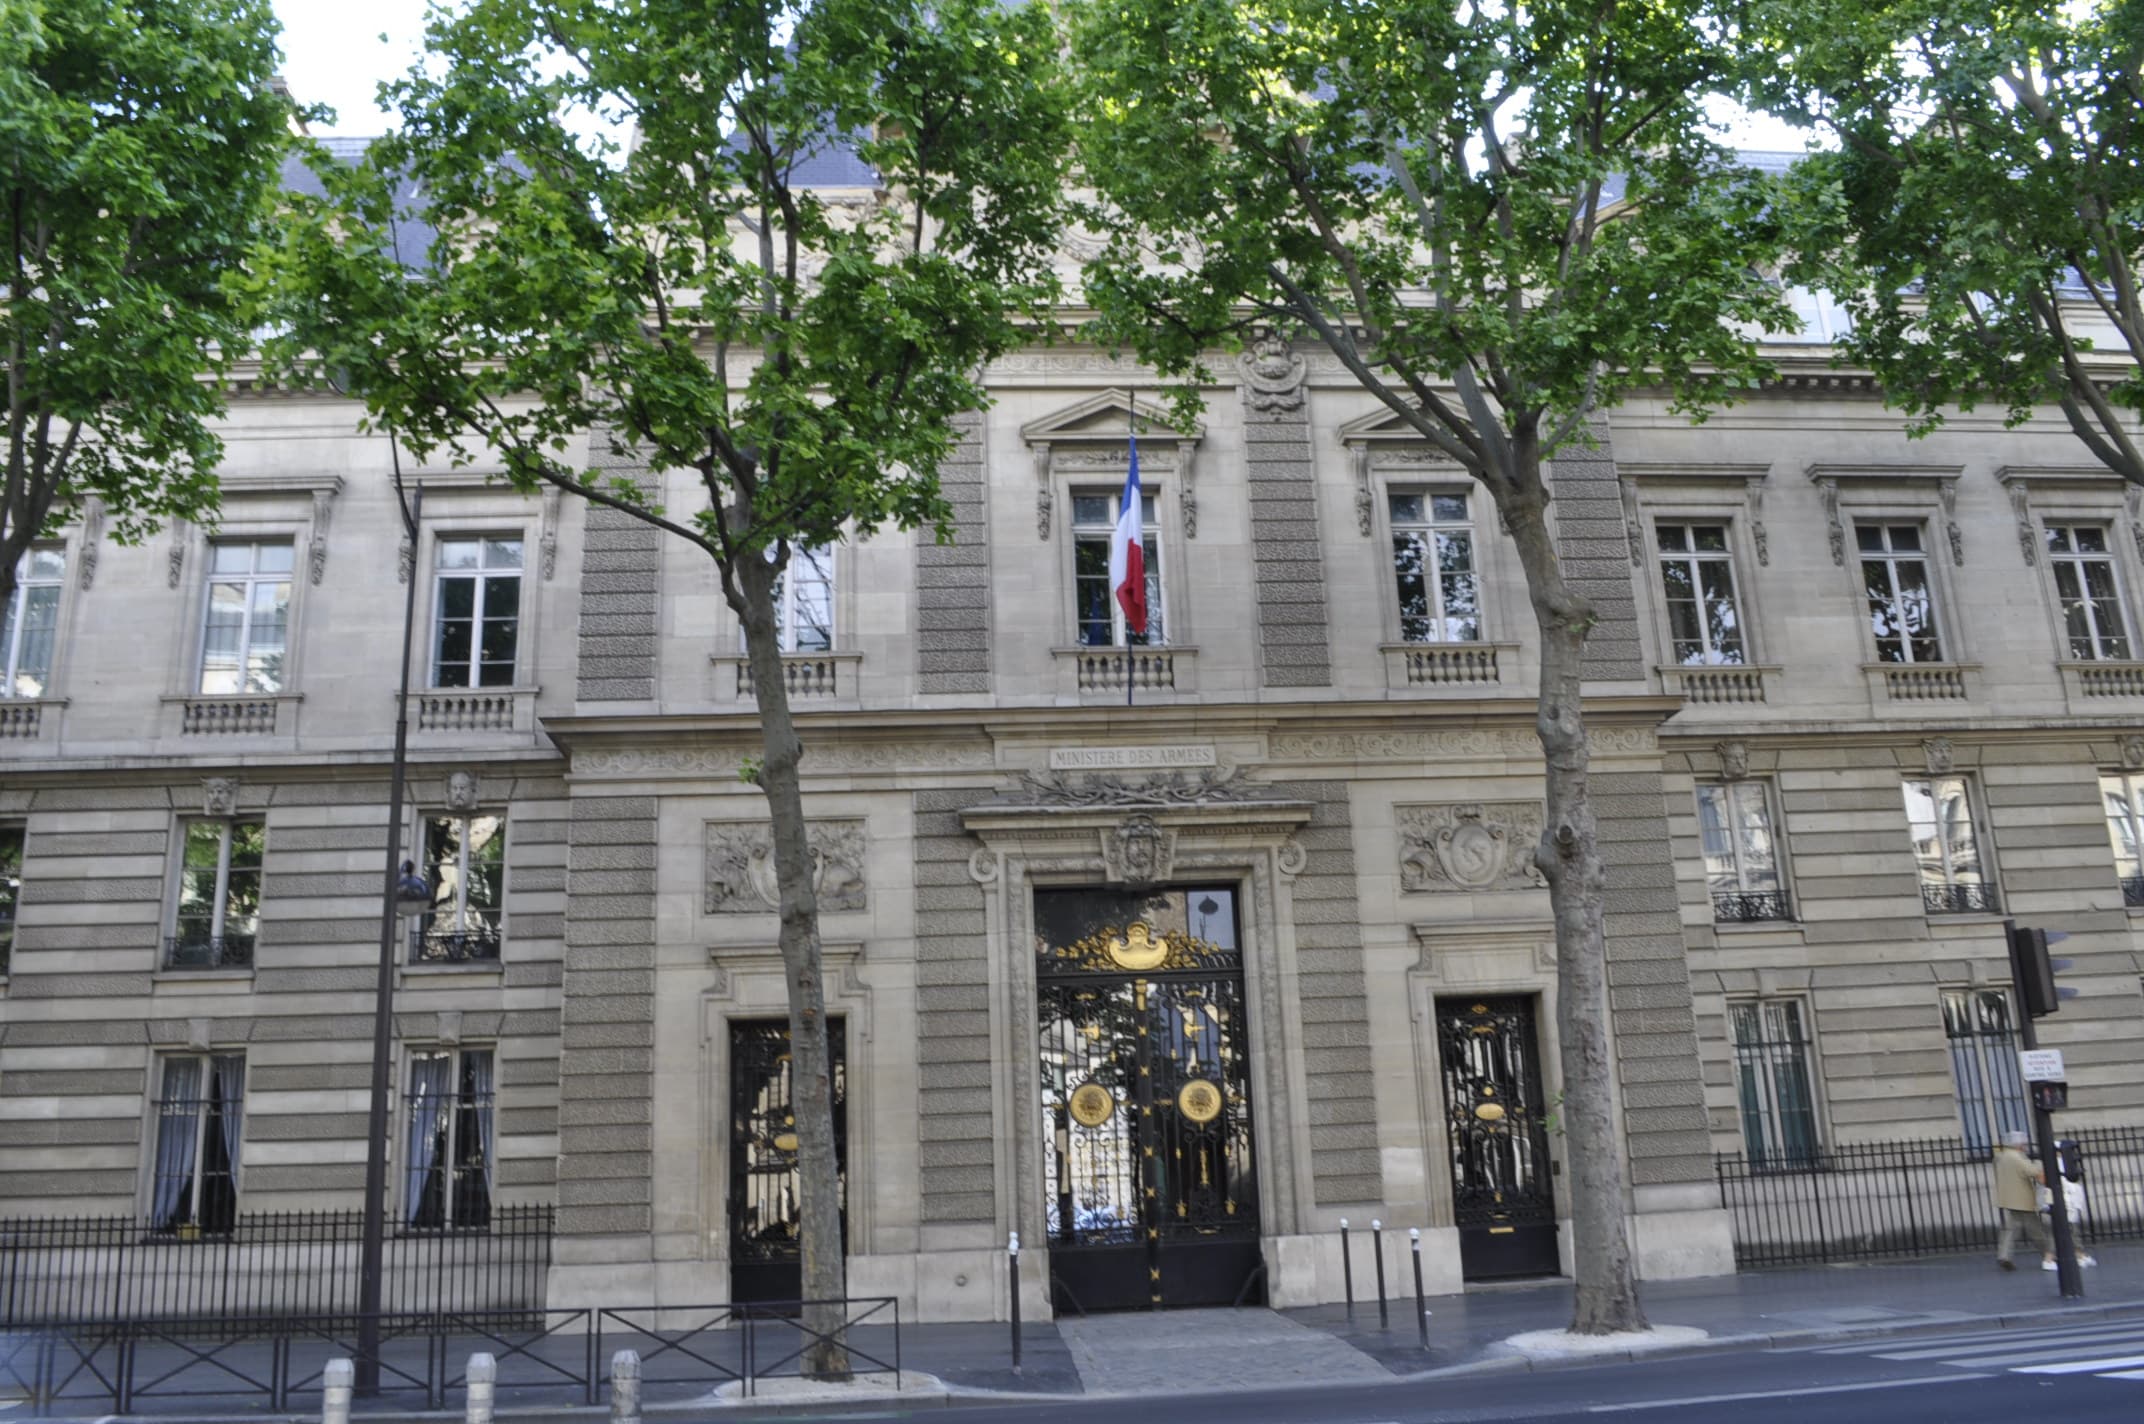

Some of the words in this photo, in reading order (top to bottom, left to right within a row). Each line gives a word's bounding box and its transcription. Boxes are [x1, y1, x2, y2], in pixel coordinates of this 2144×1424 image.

[1055, 751, 1126, 766] MINISTERE
[1129, 750, 1153, 764] DES
[1159, 748, 1210, 763] ARMEES
